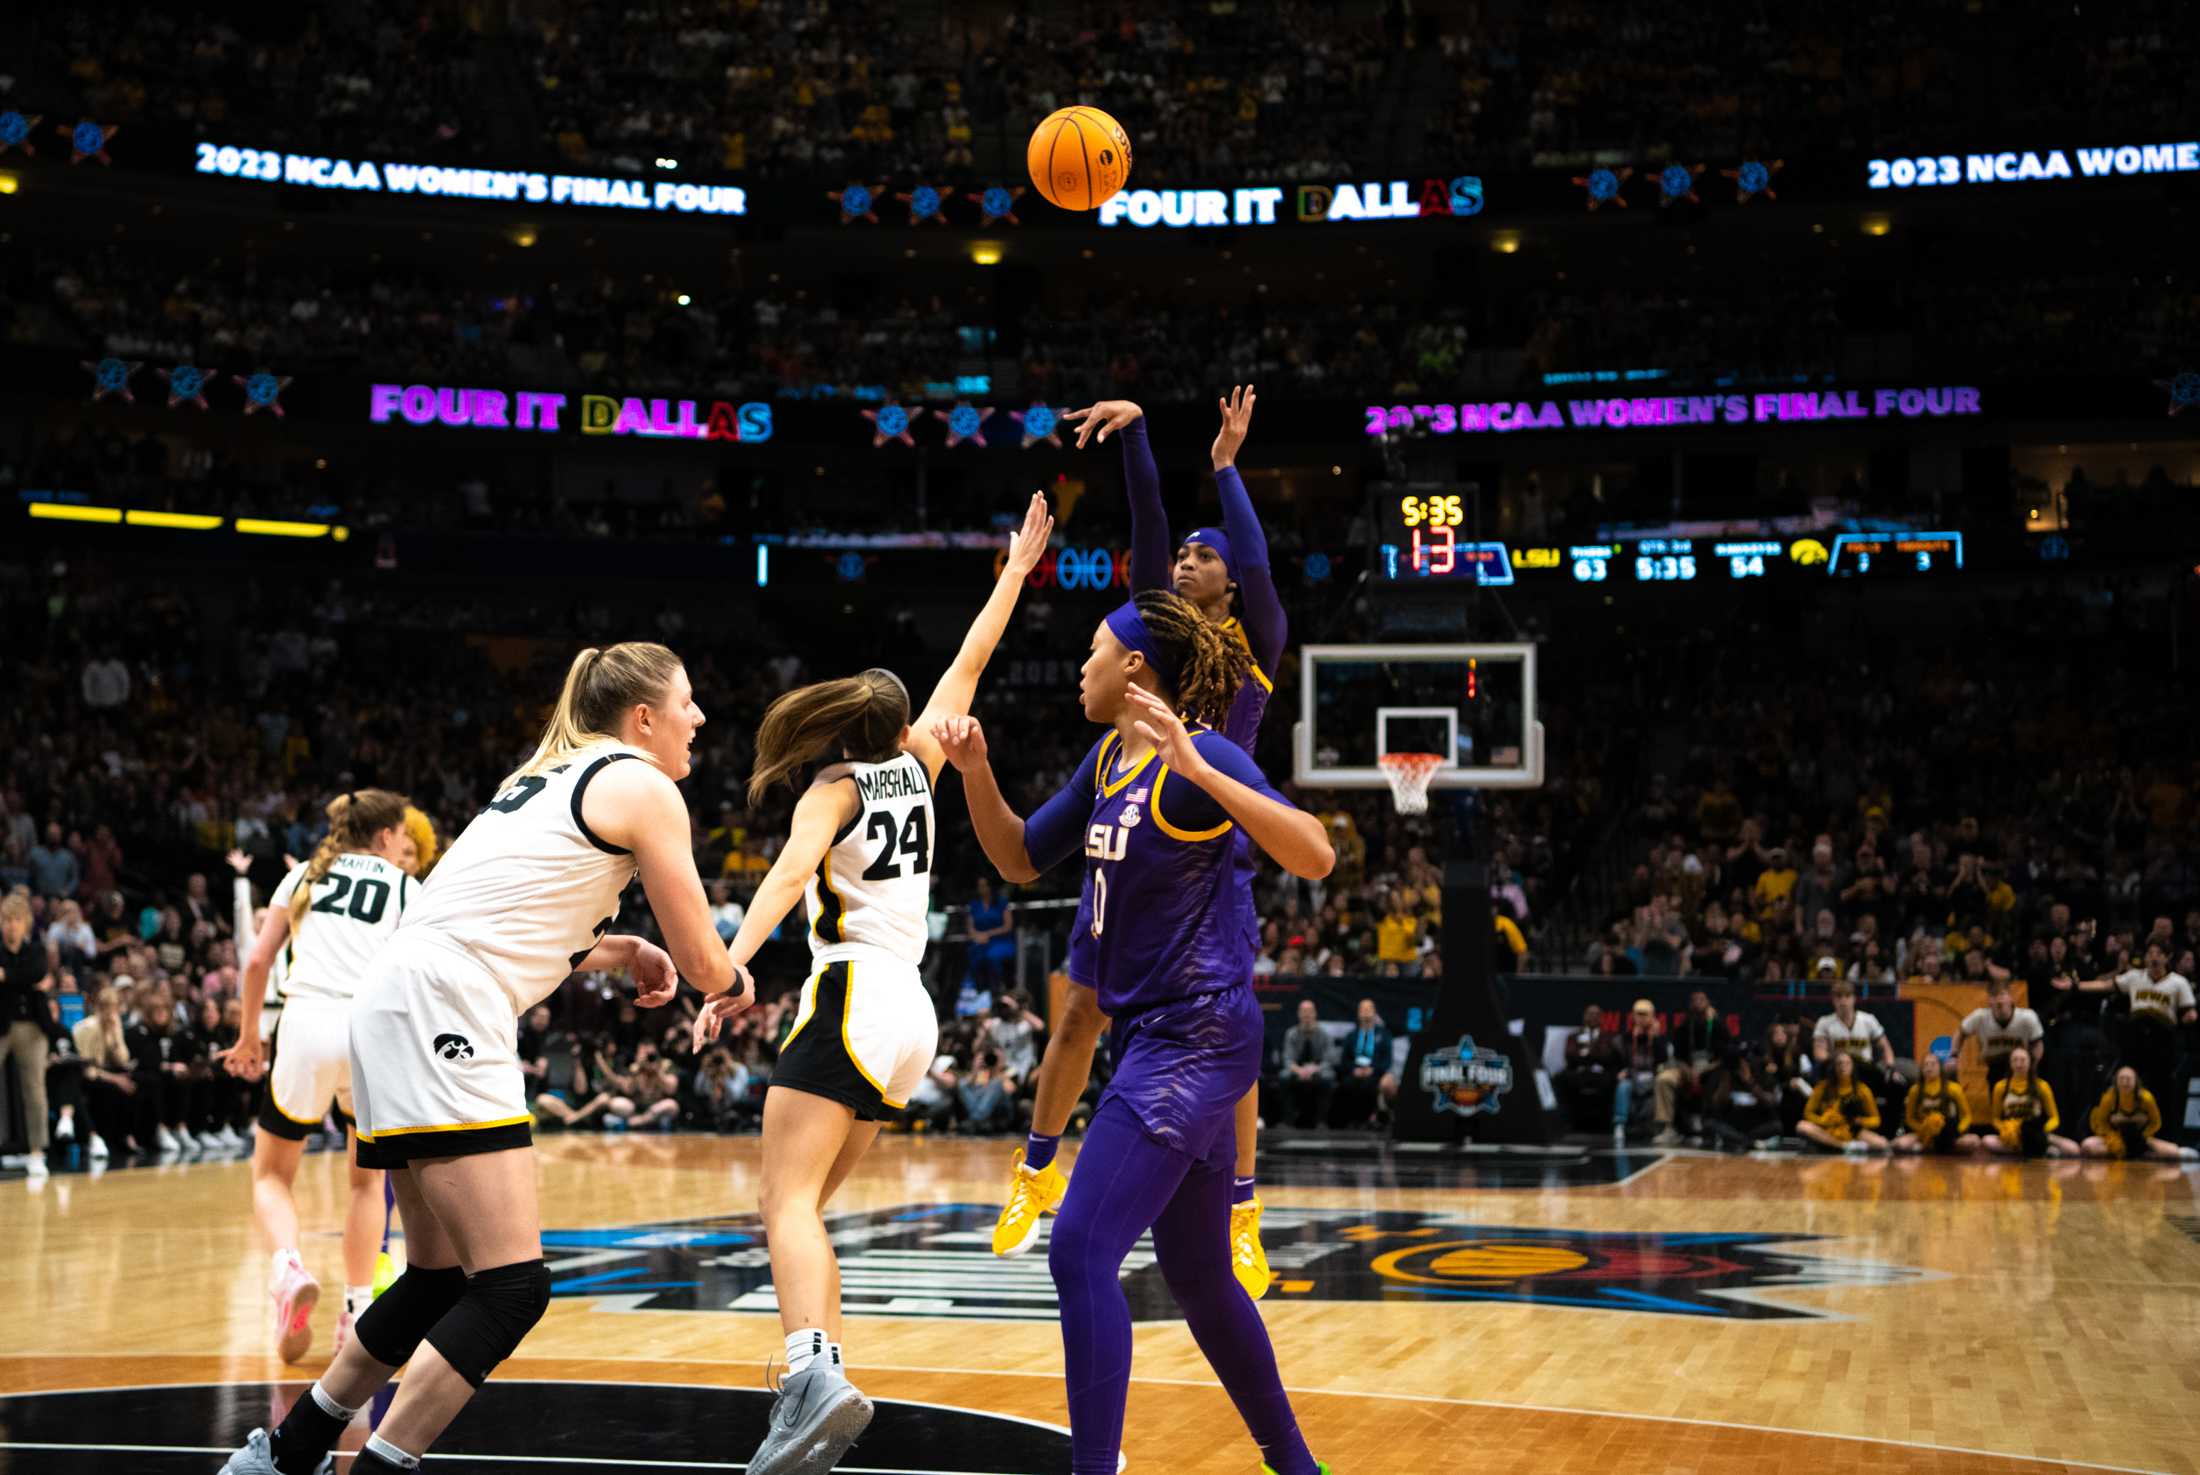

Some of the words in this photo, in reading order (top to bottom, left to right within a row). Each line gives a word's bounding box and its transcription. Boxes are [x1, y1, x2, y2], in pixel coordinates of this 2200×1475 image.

[196, 143, 281, 181] 2023
[284, 152, 381, 191] NCAA
[384, 160, 549, 203] WOMEN'S
[552, 176, 651, 209] FINAL
[654, 183, 747, 216] FOUR
[1867, 156, 1961, 189] 2023
[1966, 149, 2073, 183] NCAA
[1099, 189, 1228, 226] FOUR
[1232, 187, 1284, 225] IT
[1297, 176, 1485, 223] DALLAS
[370, 384, 509, 429] FOUR
[515, 392, 567, 431] IT
[580, 394, 774, 443] DALLAS
[1461, 397, 1566, 434] NCAA
[1569, 394, 1748, 430] WOMEN'S
[1753, 391, 1869, 424] FINAL
[1875, 386, 1981, 417] FOUR
[1401, 495, 1464, 528] 5:35
[1412, 526, 1455, 574] 13
[1513, 549, 1560, 568] LSU
[1573, 558, 1608, 582] 63
[1635, 556, 1697, 582] 5:35
[1730, 556, 1765, 579] 54
[857, 769, 927, 800] MARSHALL
[862, 805, 930, 881] 24
[311, 872, 391, 924] 20
